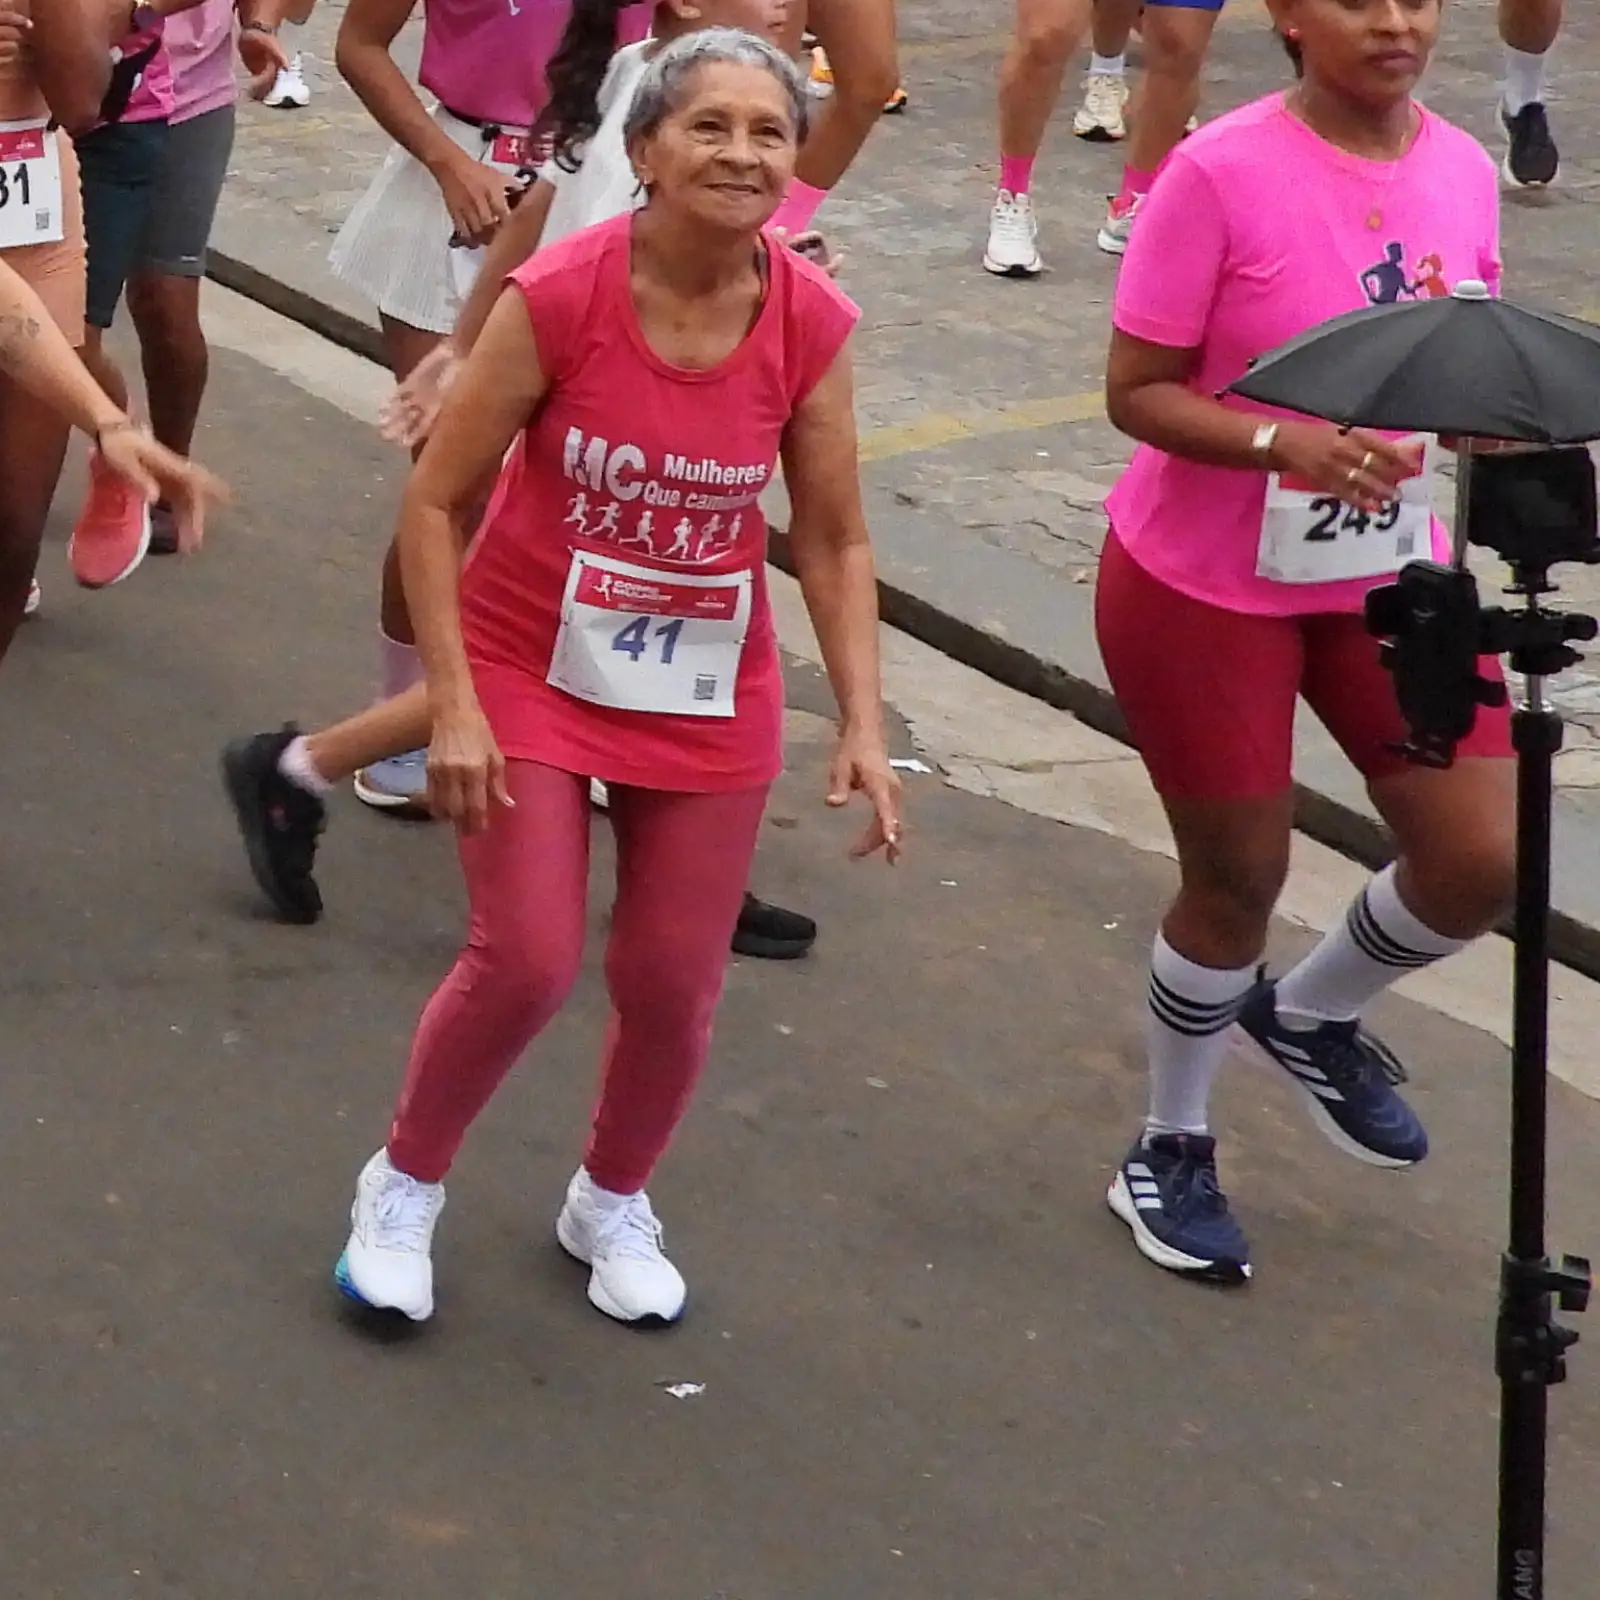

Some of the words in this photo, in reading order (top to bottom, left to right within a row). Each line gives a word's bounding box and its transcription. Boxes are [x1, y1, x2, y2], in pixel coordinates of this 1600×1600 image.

[562, 426, 648, 502] MC
[664, 453, 768, 487] Mulheres
[642, 482, 681, 511] Que
[1305, 498, 1400, 541] 249
[611, 616, 685, 665] 41
